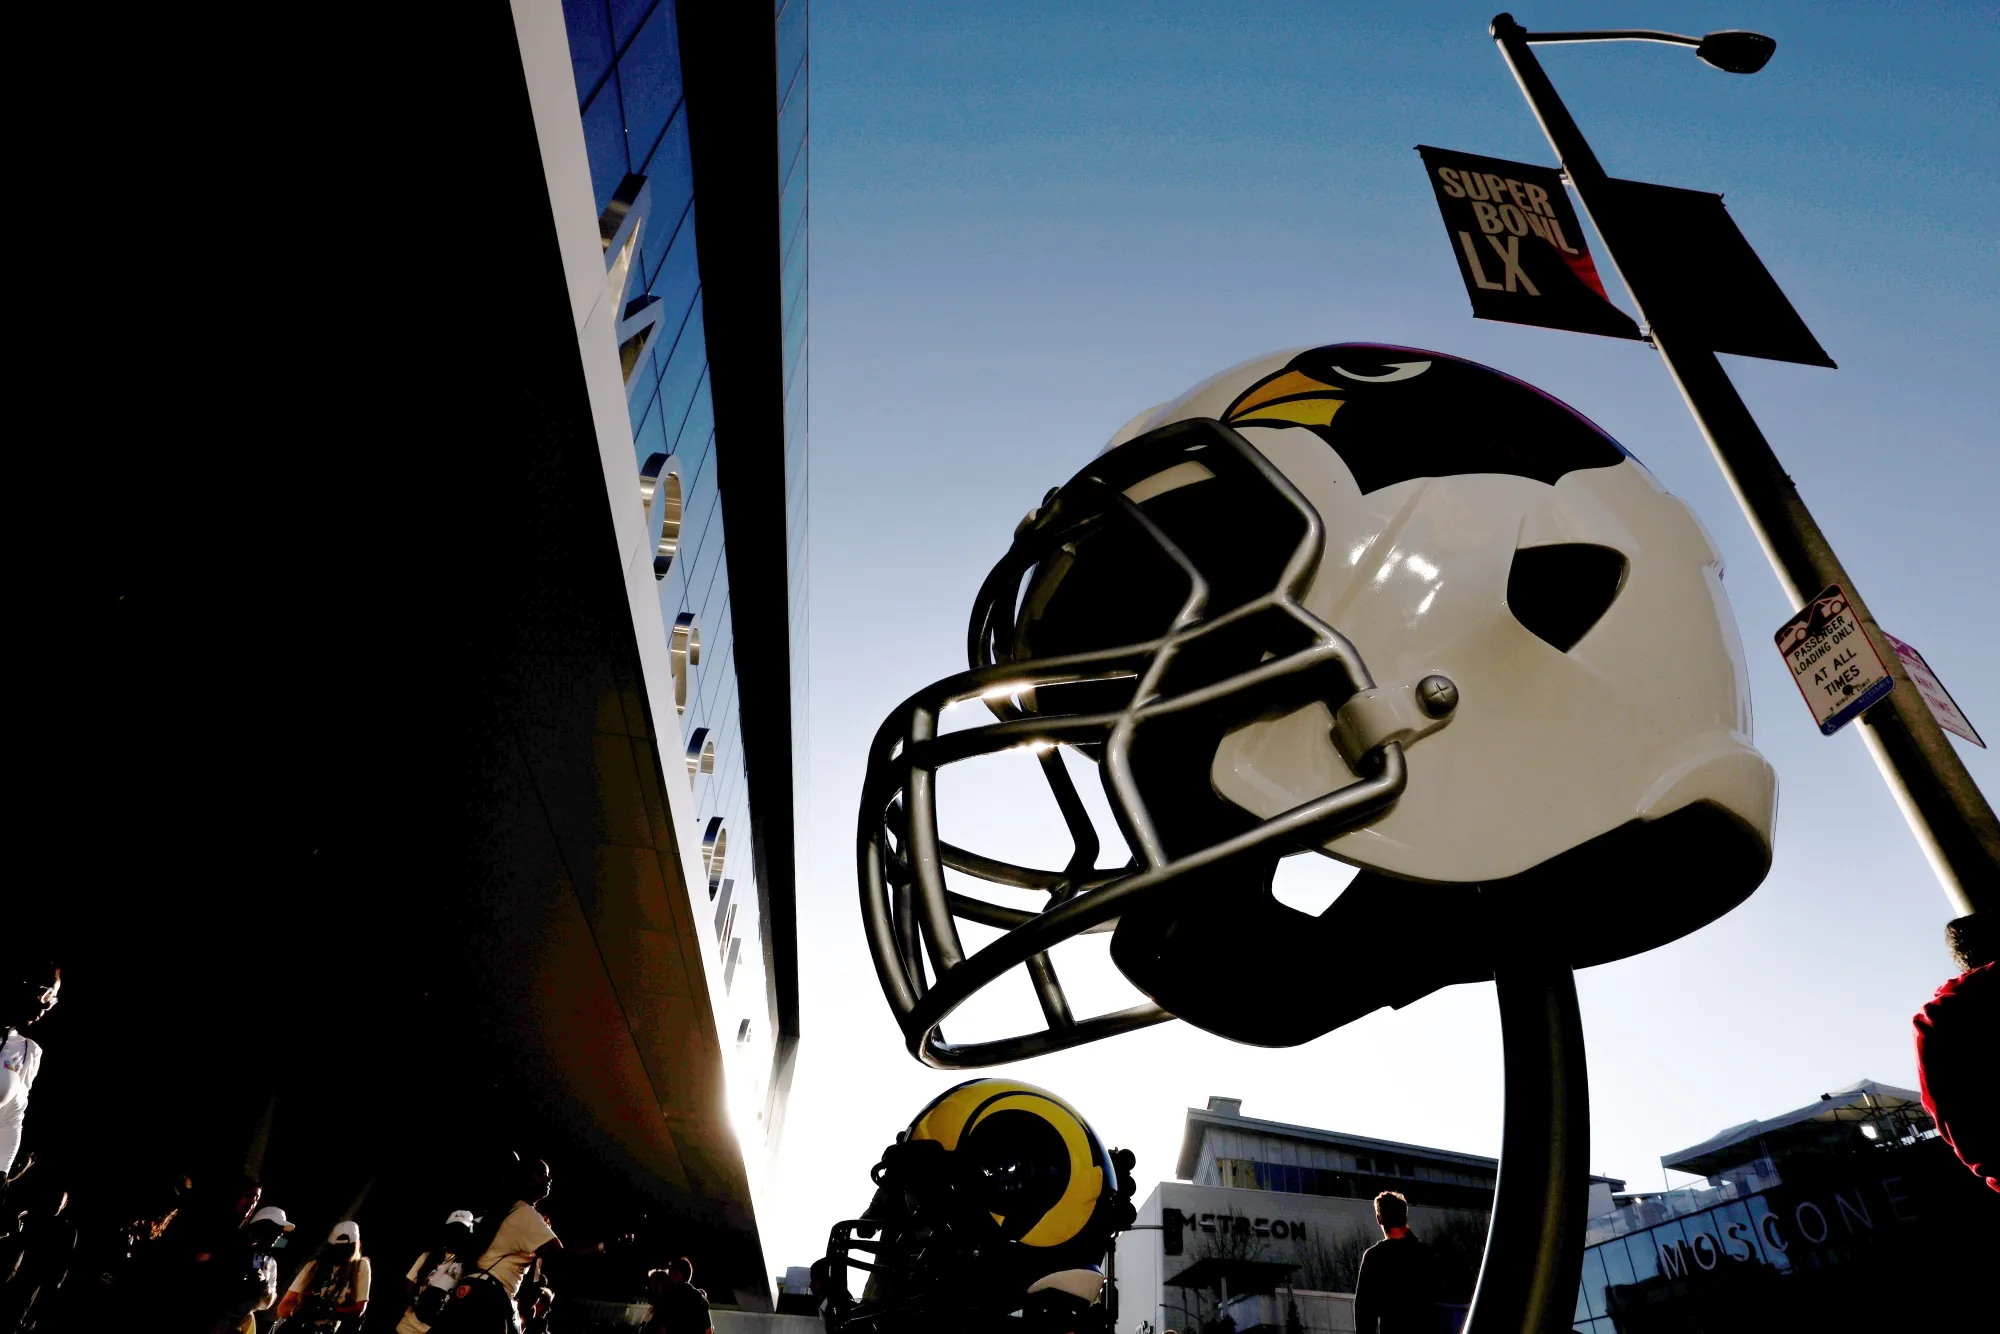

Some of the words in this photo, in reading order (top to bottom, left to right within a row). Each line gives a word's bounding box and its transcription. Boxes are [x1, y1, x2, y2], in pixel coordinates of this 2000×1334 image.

[1438, 167, 1556, 218] SUPER
[1472, 201, 1579, 255] BOWL
[1458, 231, 1541, 296] LX
[1794, 615, 1845, 660] PASSENGER
[1795, 642, 1831, 676] LOADING
[1832, 621, 1856, 645] ONLY
[1813, 667, 1828, 685] AT
[1833, 648, 1857, 671] ALL
[1824, 665, 1860, 696] TIMES
[1181, 1213, 1307, 1241] METREON
[1658, 1174, 1919, 1280] MOSCONE
